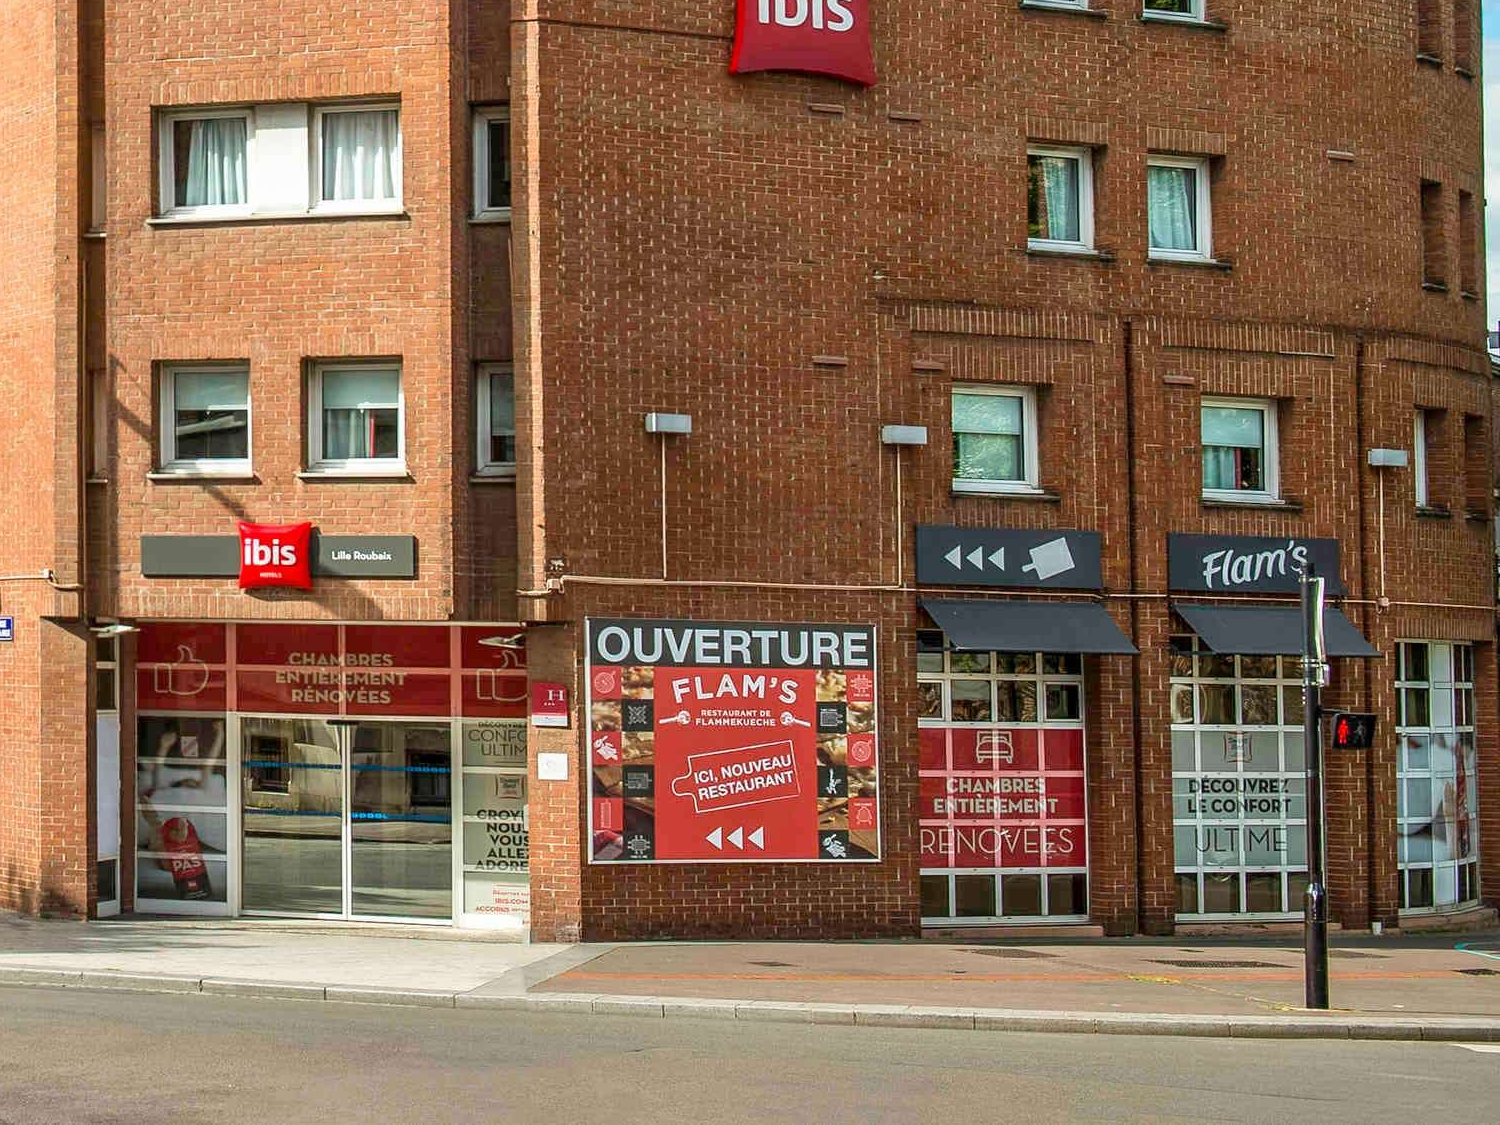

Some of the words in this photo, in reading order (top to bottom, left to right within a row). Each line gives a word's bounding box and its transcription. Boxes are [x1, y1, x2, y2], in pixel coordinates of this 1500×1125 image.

[244, 538, 297, 566] ibis
[331, 550, 352, 561] Lille
[353, 551, 392, 562] Roubaix
[1202, 540, 1308, 589] Flam's
[596, 626, 869, 667] OUVERTURE
[288, 652, 394, 667] CHAMBRES
[291, 685, 392, 704] RÉNOVÉES
[671, 674, 799, 704] FLAM'S
[695, 718, 776, 727] FLAMMEKUECHE
[700, 709, 758, 718] RESTAURANT
[760, 709, 772, 718] DE
[694, 769, 719, 784] ICI,
[720, 755, 792, 779] NOUVEAU
[698, 771, 794, 801] RESTAURANT
[946, 778, 1046, 793] CHAMBRES
[1188, 775, 1289, 793] DÉCOUVREZ
[933, 793, 1059, 814] ENTIÈREMENT
[1187, 799, 1208, 813] LE
[1211, 799, 1291, 813] CONFORT
[919, 822, 1074, 854] RÉNOVÉES
[1195, 827, 1288, 852] ULTME
